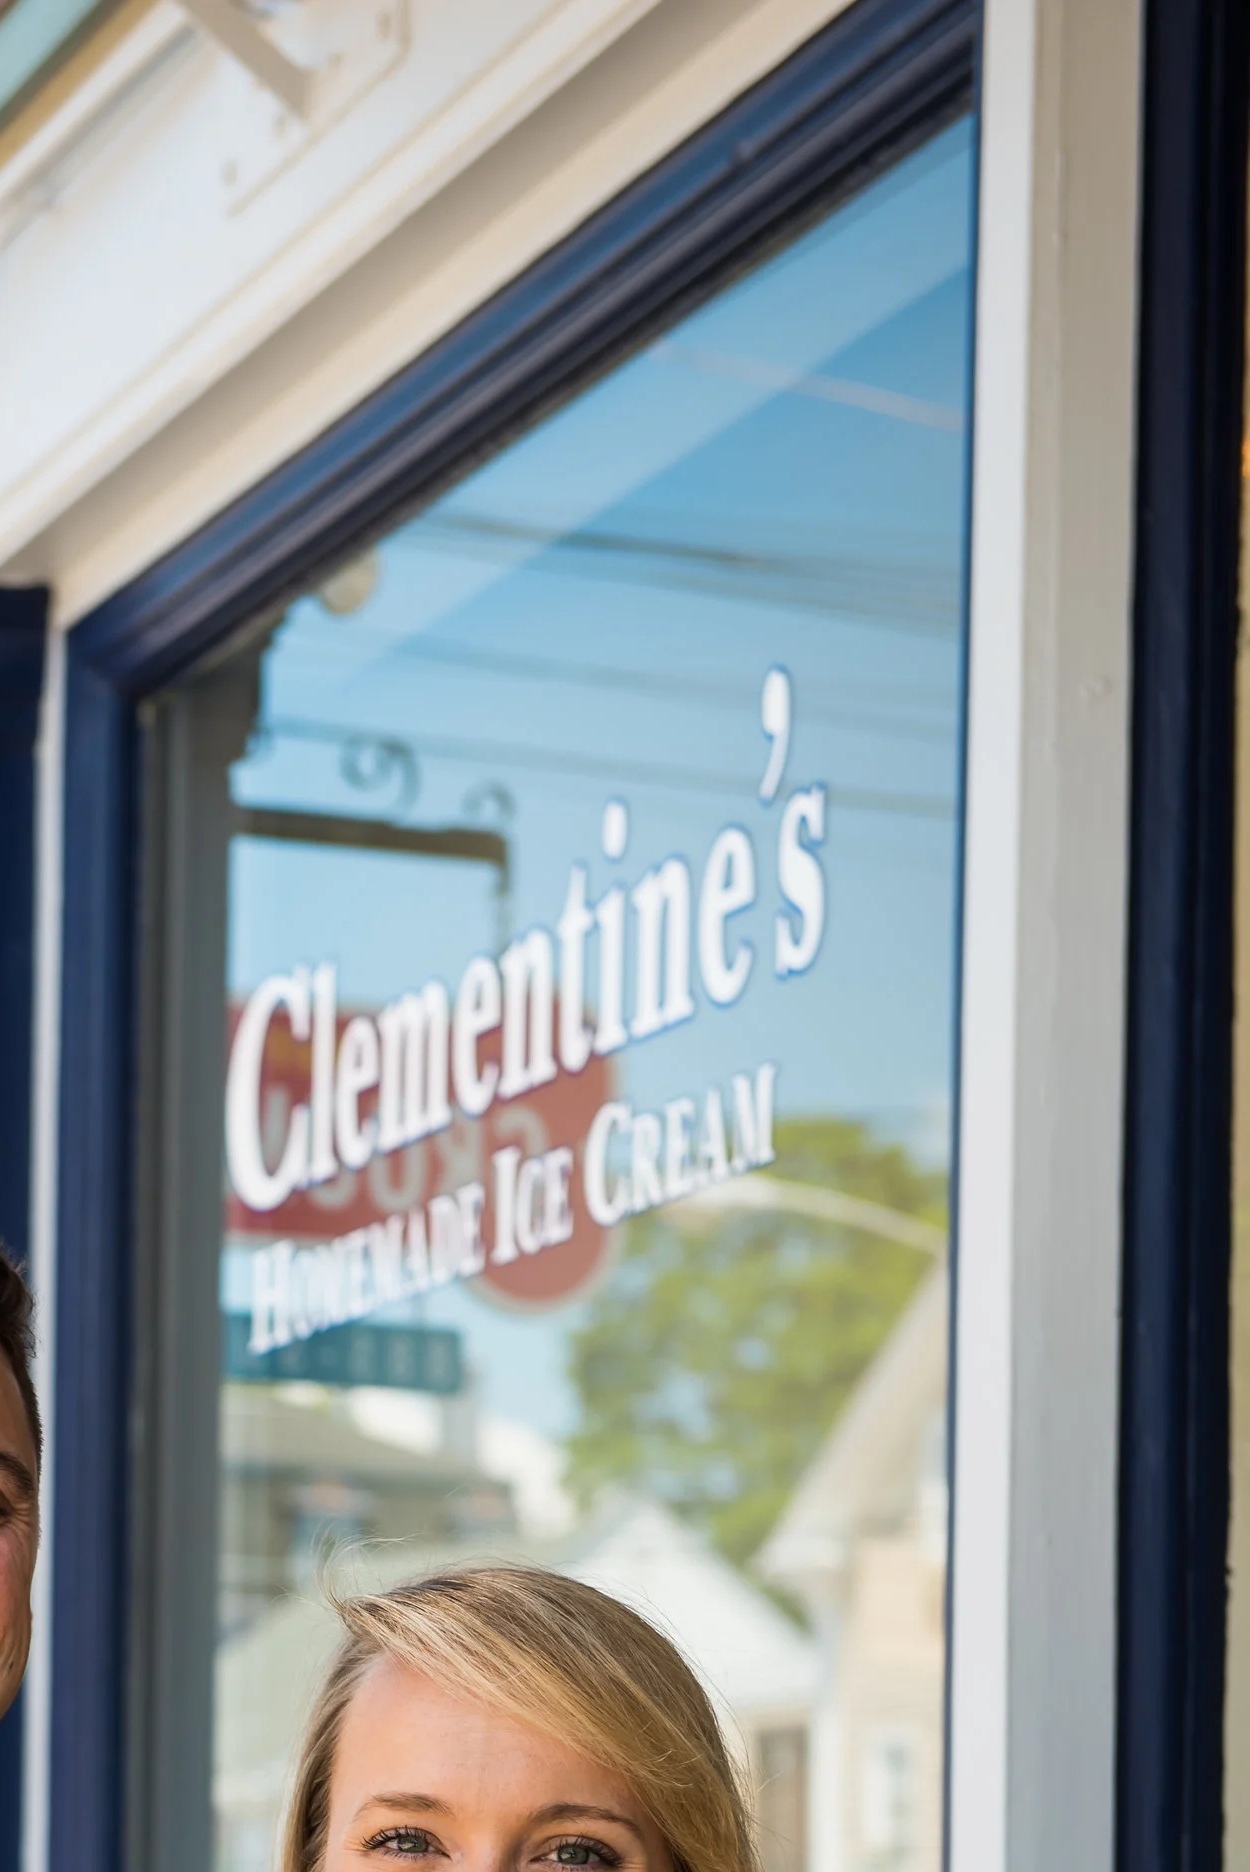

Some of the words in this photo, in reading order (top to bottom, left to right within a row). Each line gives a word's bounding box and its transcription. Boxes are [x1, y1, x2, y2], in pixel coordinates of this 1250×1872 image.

[226, 664, 827, 1211] Clementine's
[247, 1181, 487, 1357] HOMEMADE
[490, 1145, 574, 1266] ICE
[583, 1061, 778, 1227] CREAM
